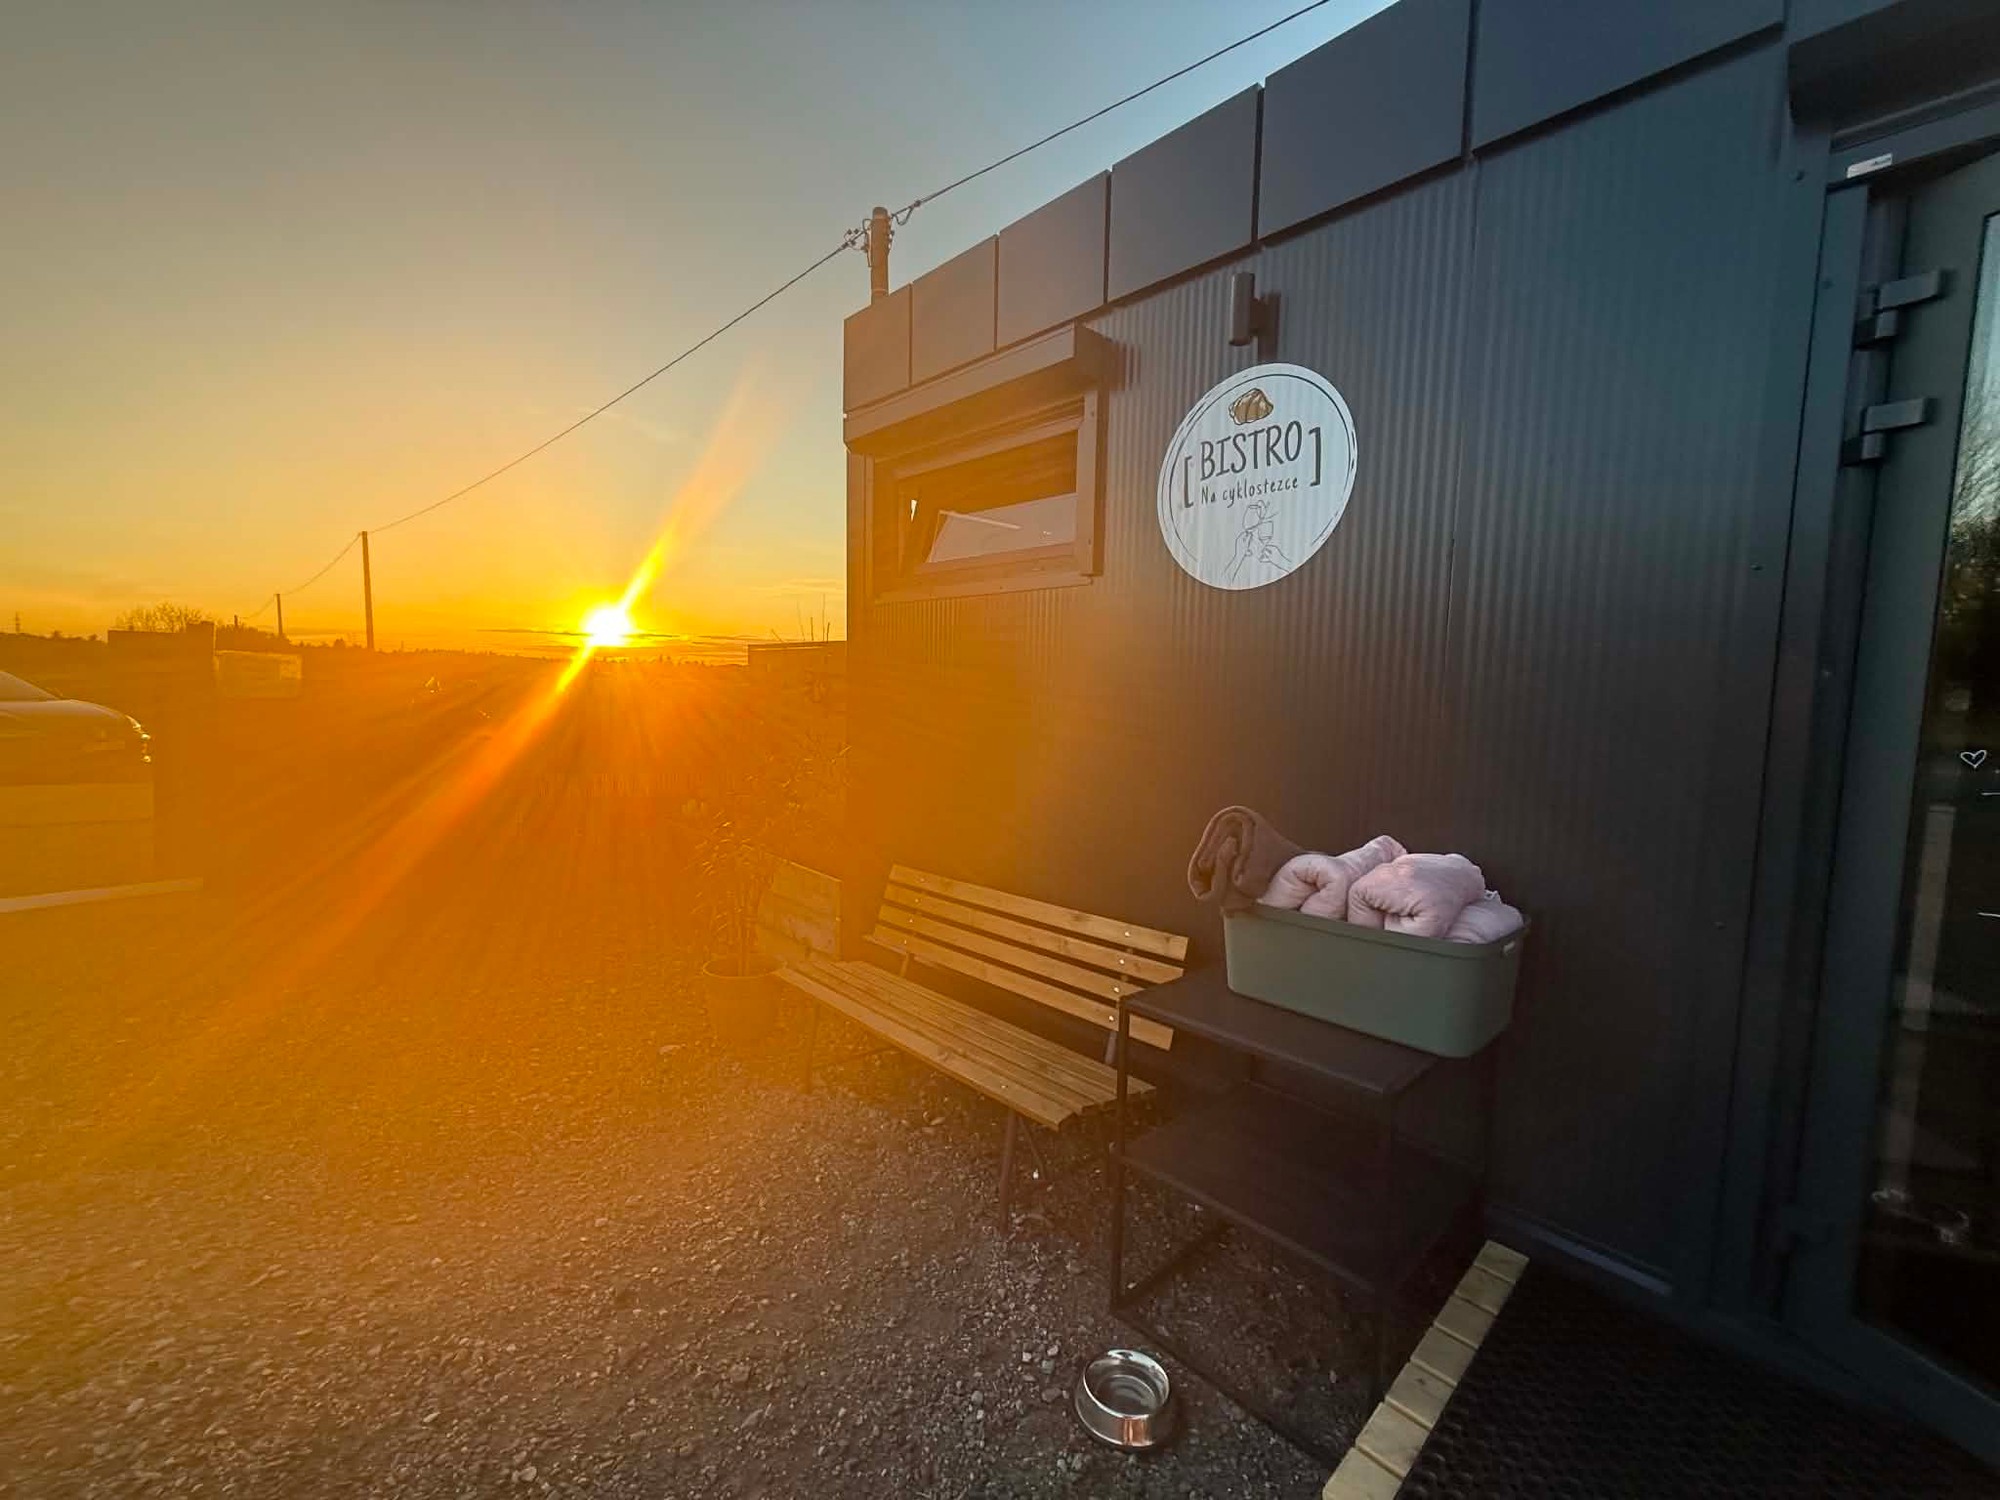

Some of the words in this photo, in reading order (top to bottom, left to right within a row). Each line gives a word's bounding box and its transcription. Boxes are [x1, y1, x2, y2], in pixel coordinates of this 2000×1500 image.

[1200, 421, 1302, 481] BISTRO
[1201, 486, 1216, 504] Na
[1222, 477, 1298, 508] cyklostezce
